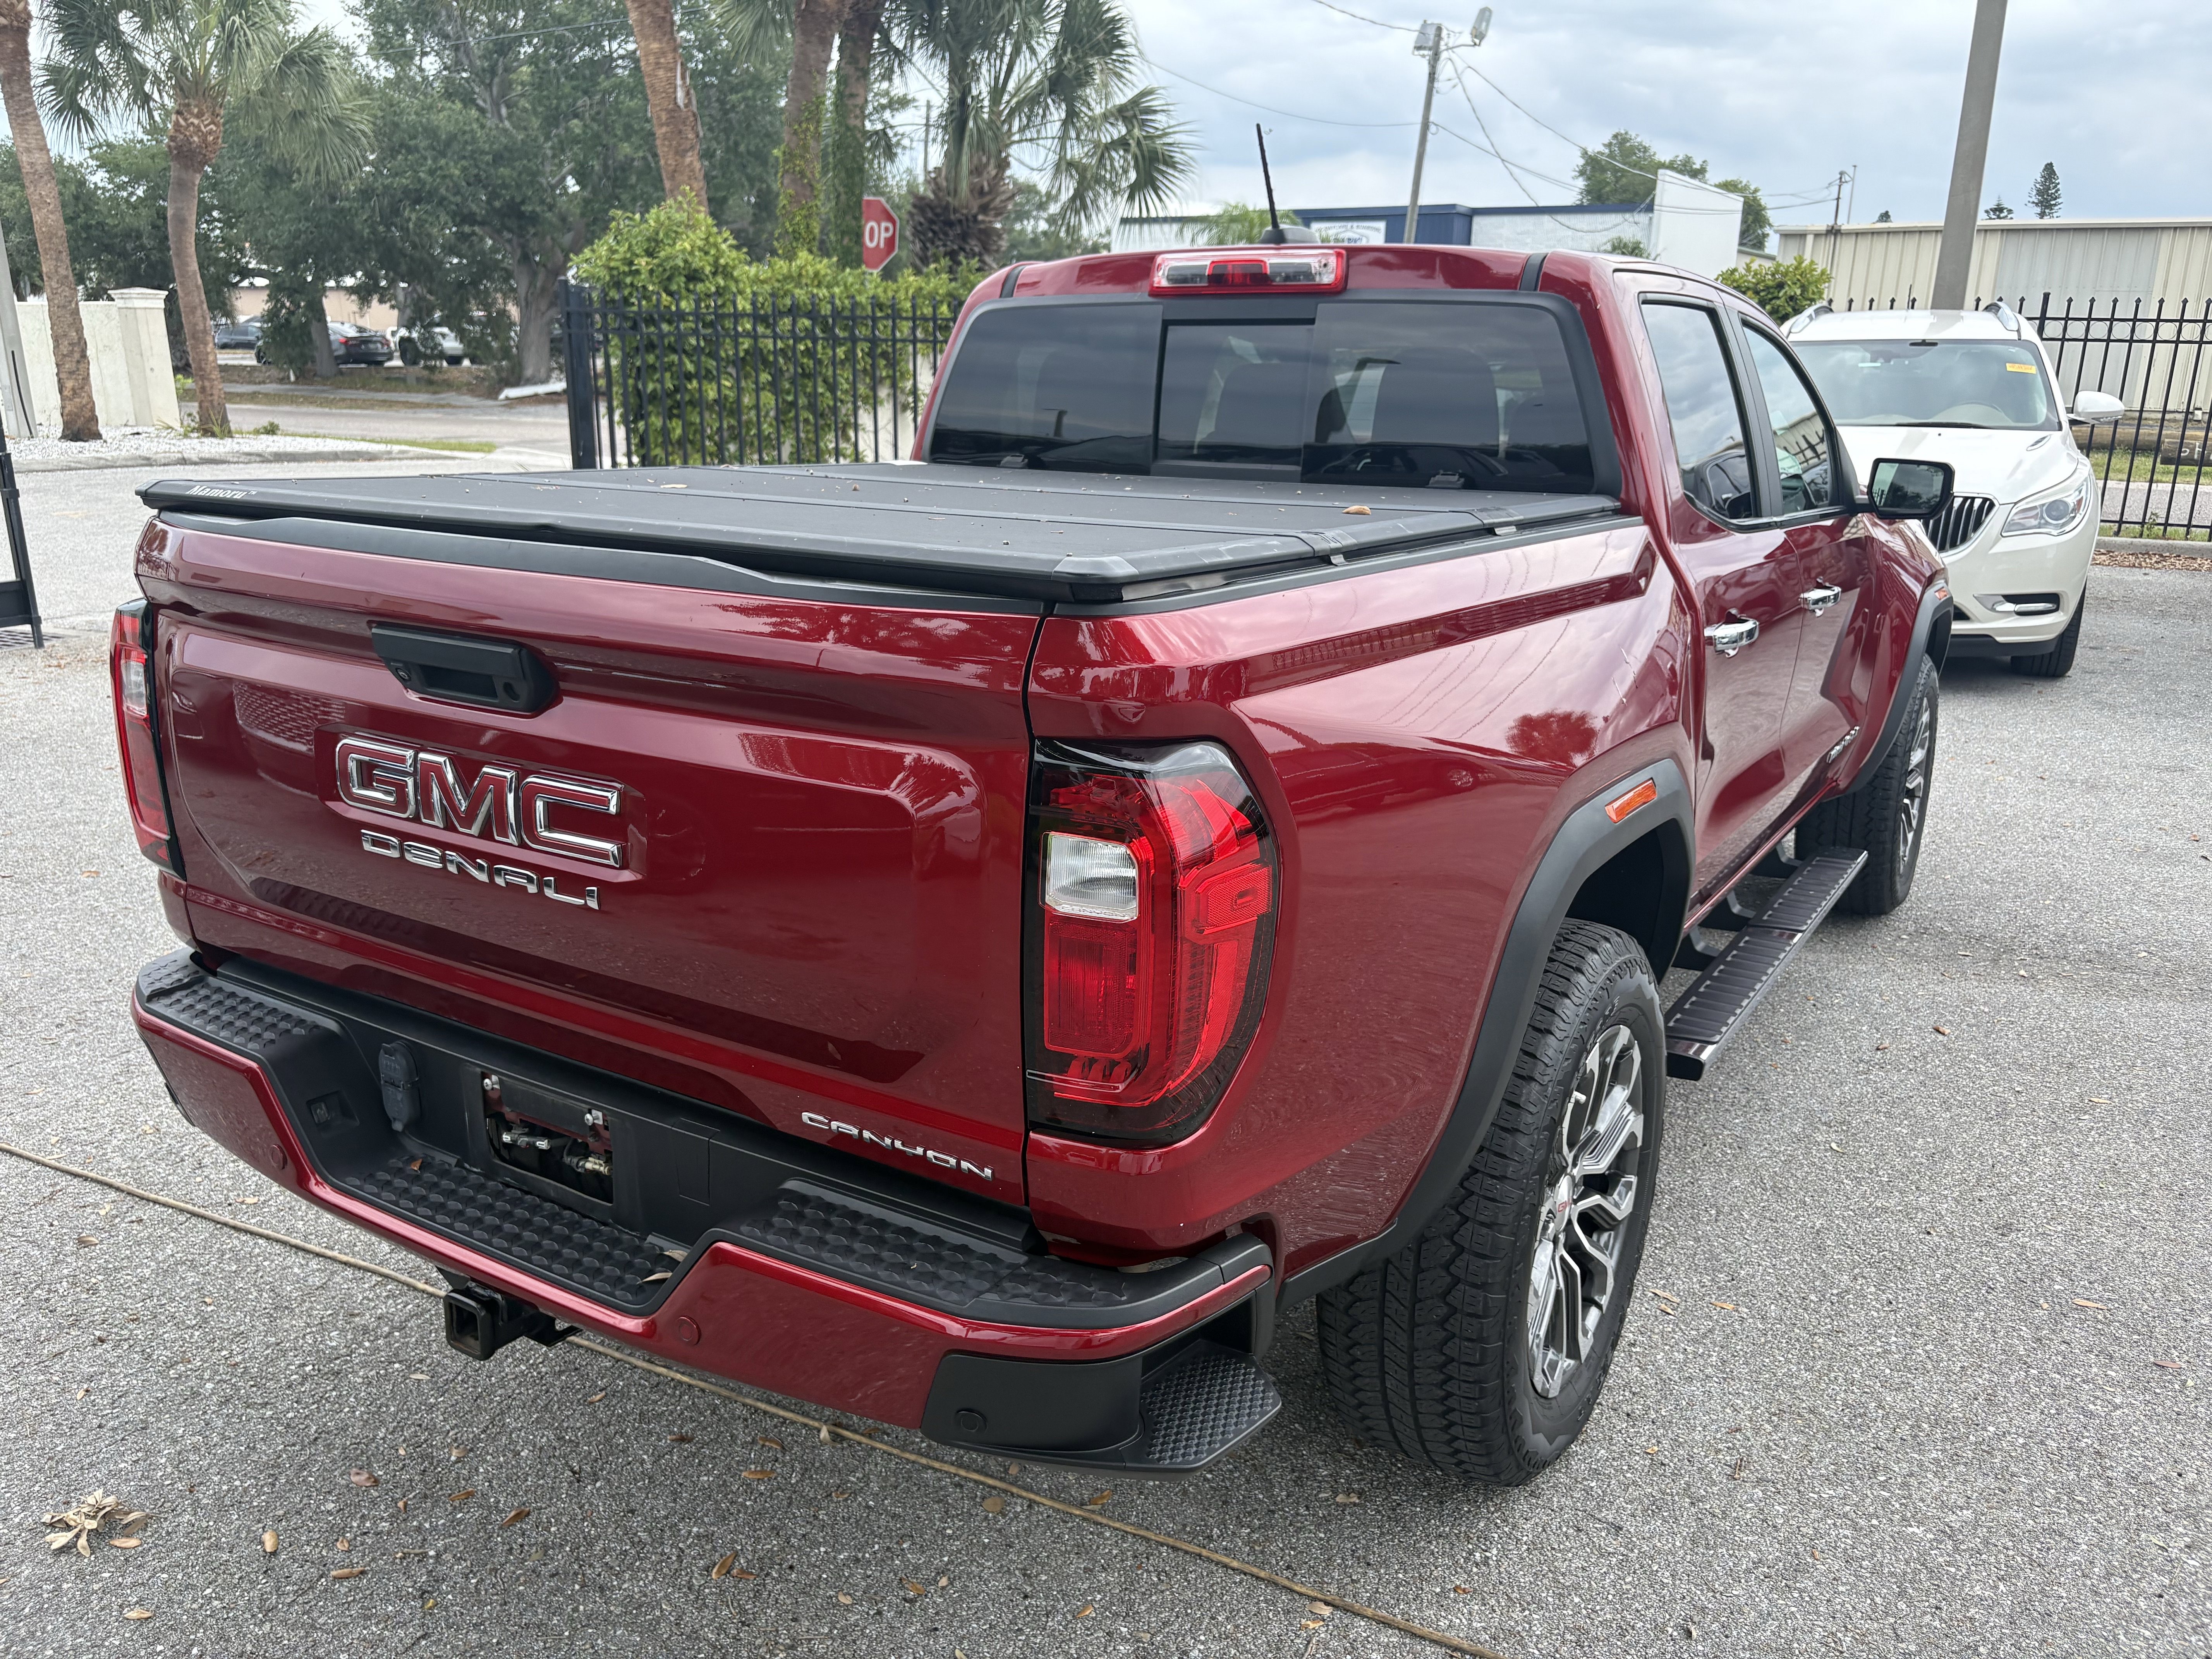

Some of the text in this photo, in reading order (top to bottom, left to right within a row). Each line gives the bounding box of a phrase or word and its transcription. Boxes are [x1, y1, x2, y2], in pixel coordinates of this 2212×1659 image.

[865, 221, 894, 249] OP
[336, 737, 623, 868] GMC
[361, 829, 601, 910] DENALI
[802, 1111, 994, 1181] CANYON
